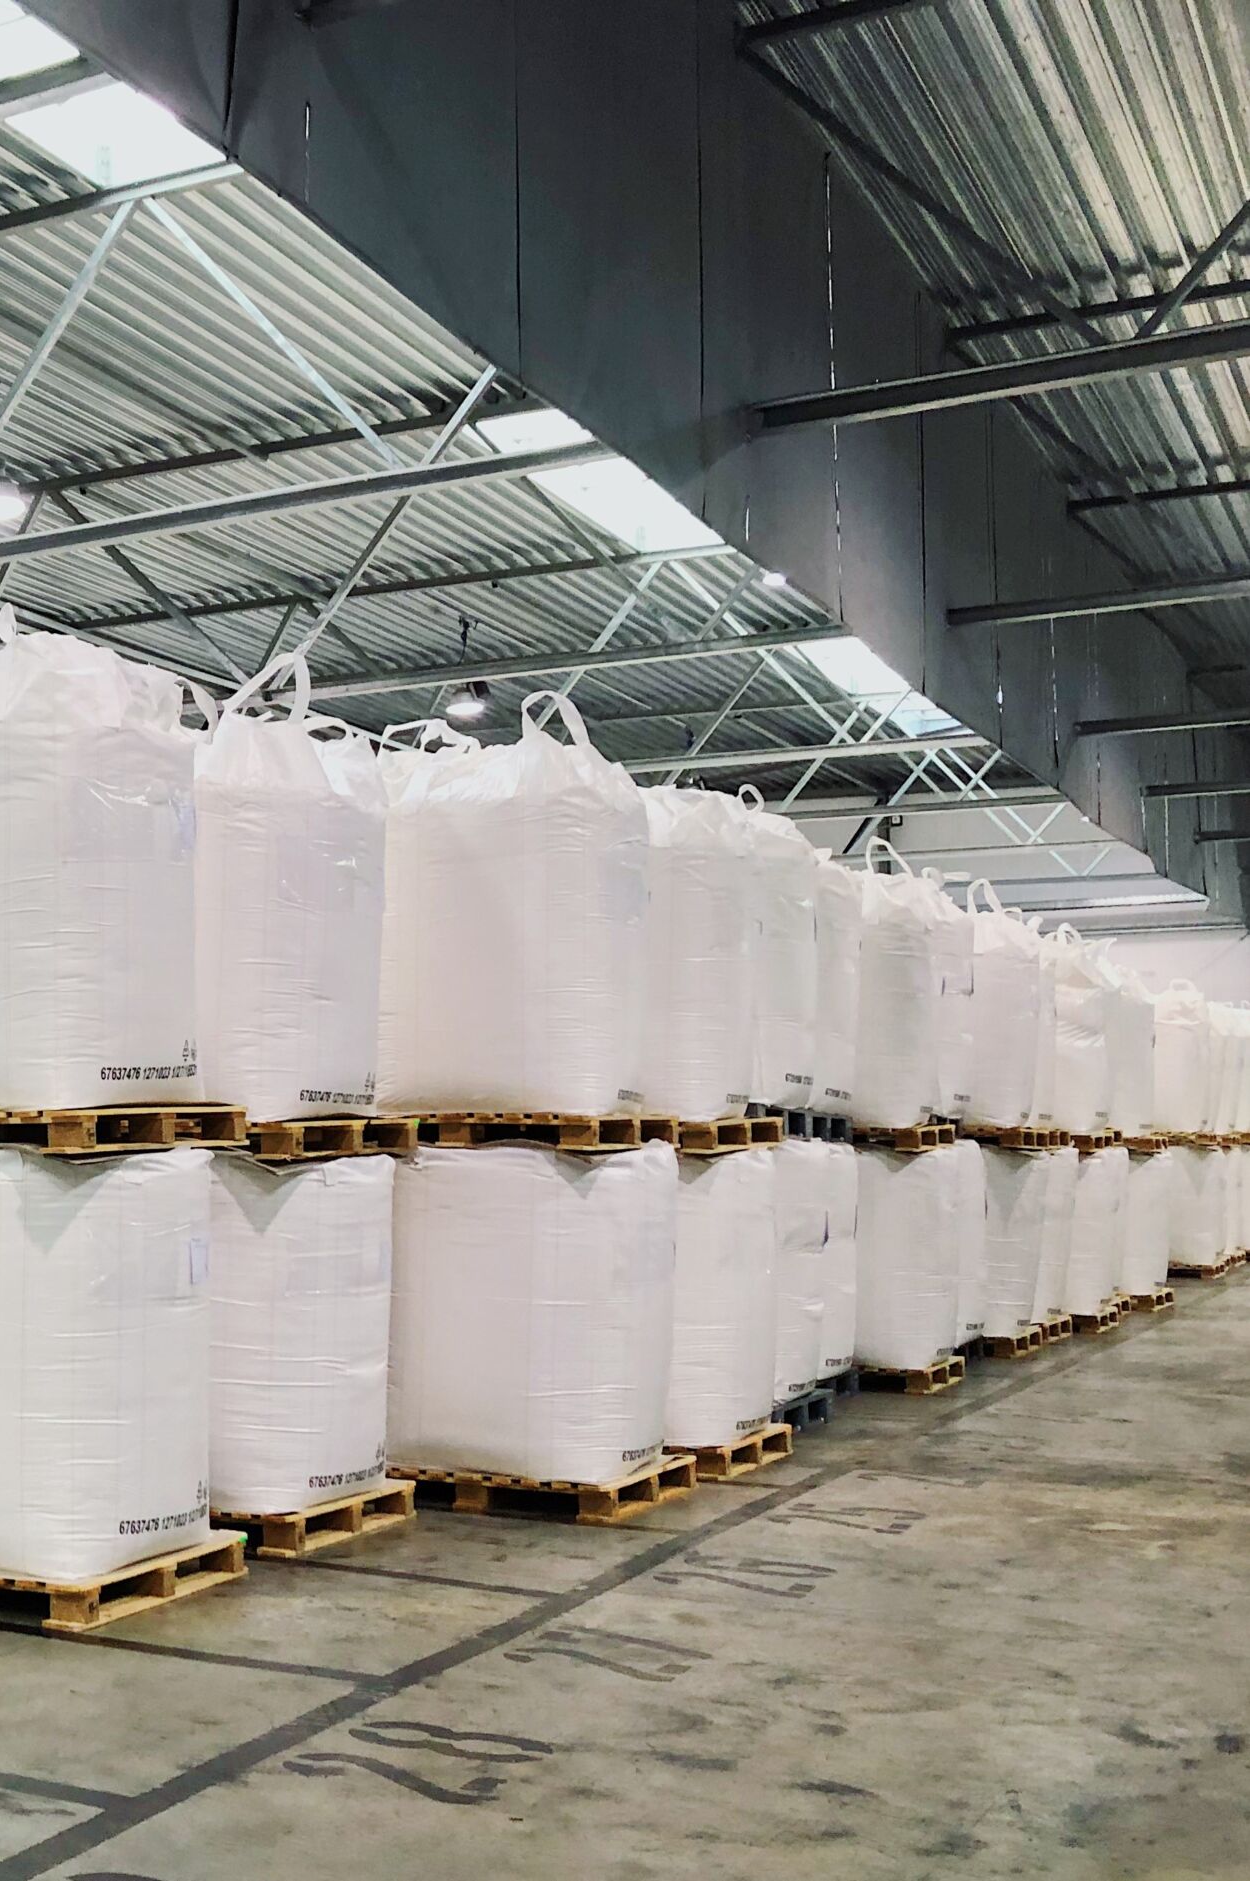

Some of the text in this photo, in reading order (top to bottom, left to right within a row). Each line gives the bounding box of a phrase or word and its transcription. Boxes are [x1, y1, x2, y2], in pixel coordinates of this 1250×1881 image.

[100, 1066, 141, 1081] 67637476
[119, 1517, 160, 1535] 67637476
[502, 1624, 713, 1683] 27
[282, 1721, 553, 1805] 28
